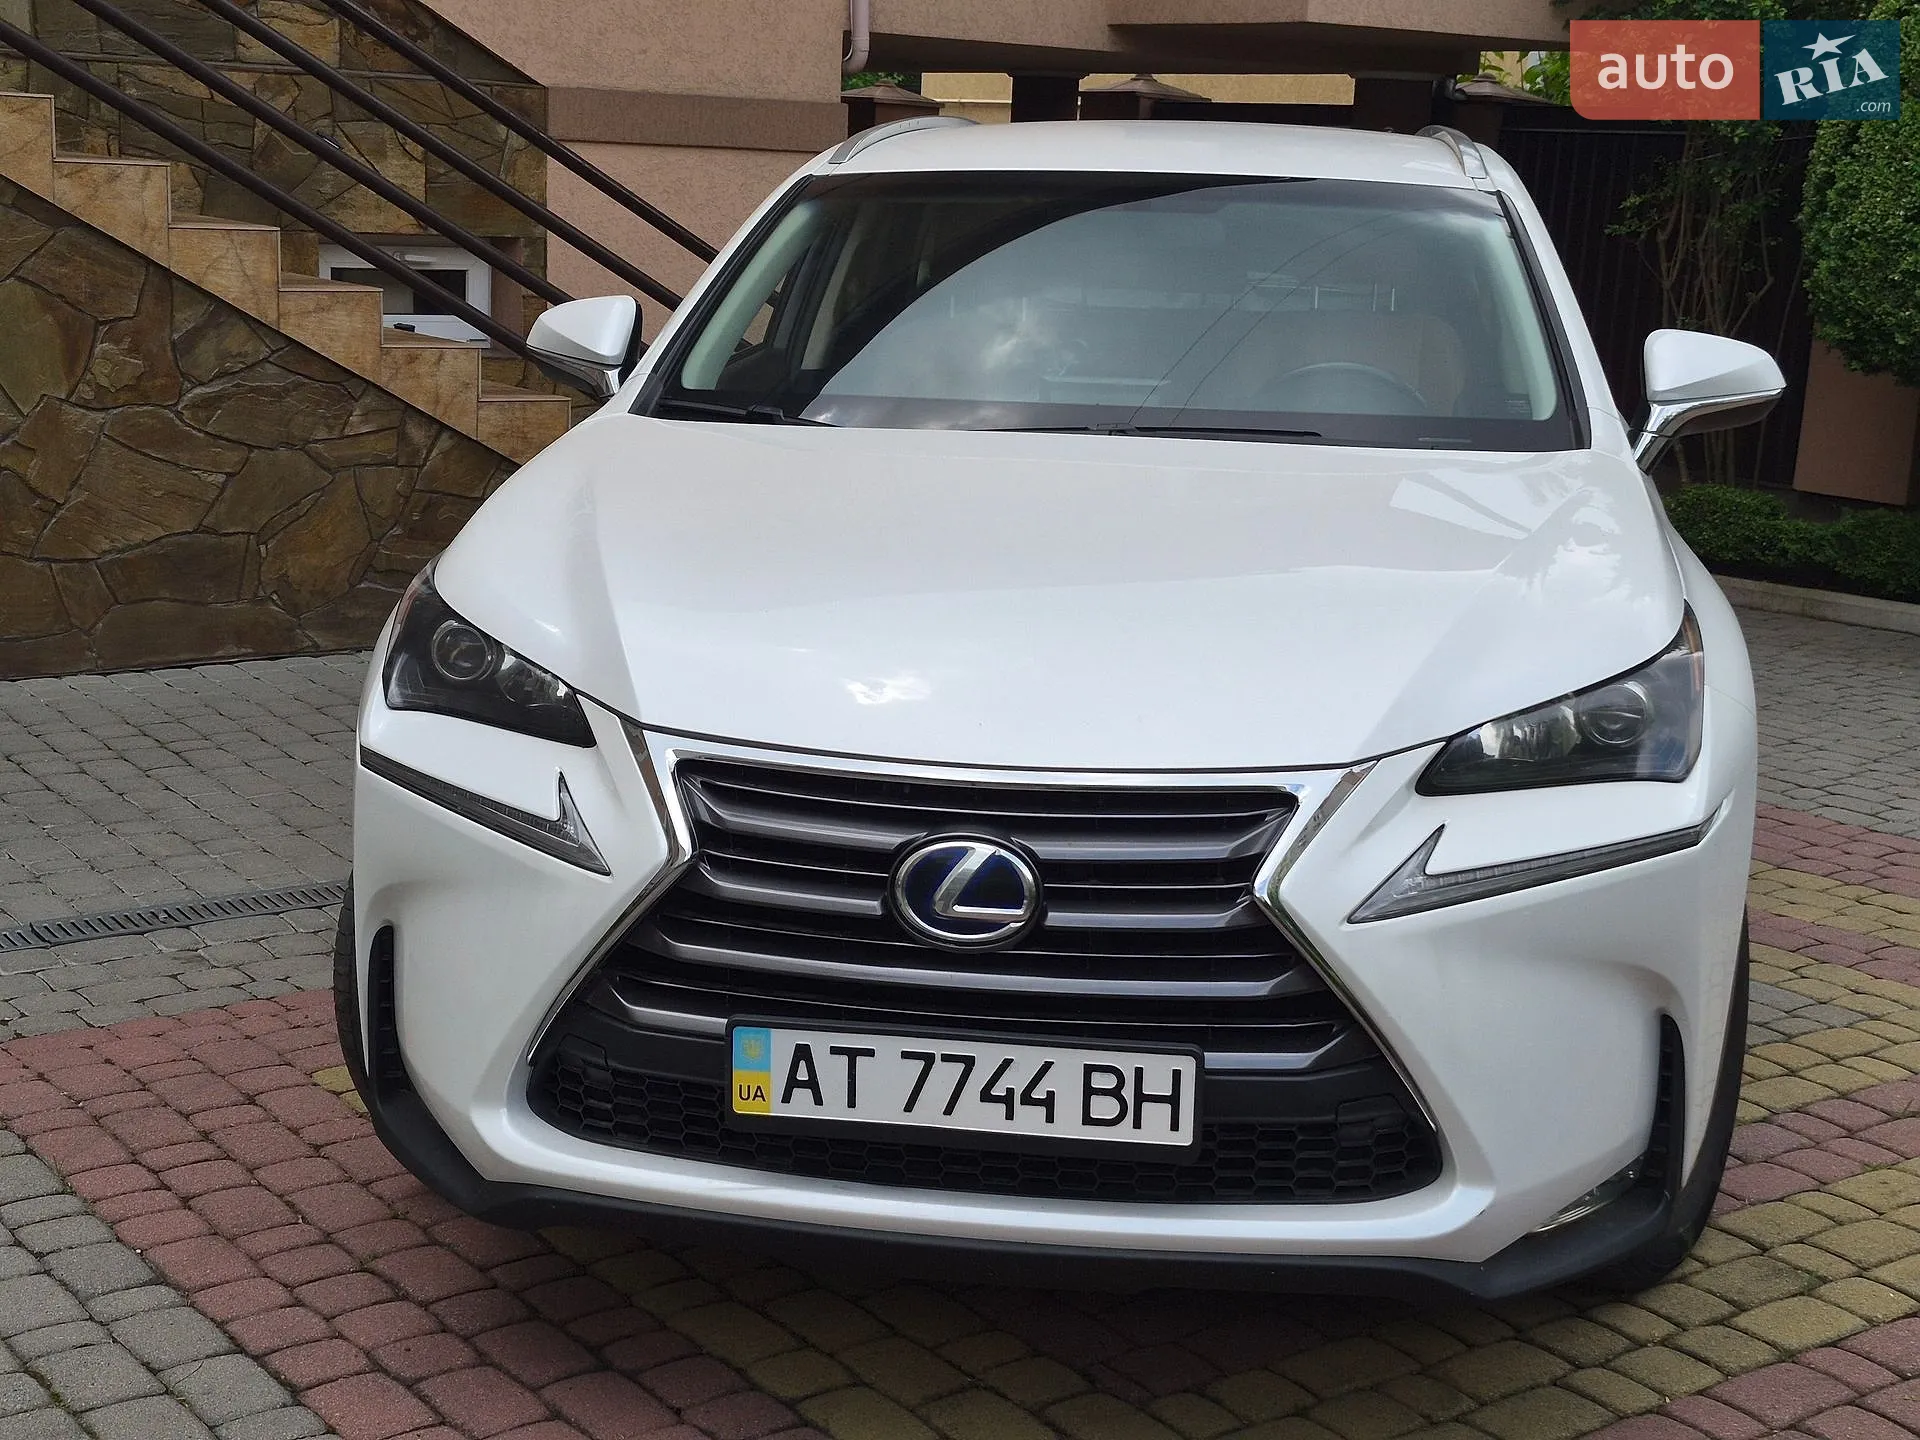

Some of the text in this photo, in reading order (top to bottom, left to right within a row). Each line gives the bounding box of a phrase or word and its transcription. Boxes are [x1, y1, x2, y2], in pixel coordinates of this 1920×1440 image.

[738, 1084, 767, 1102] UA
[781, 1043, 1182, 1132] AT 7744 BH
